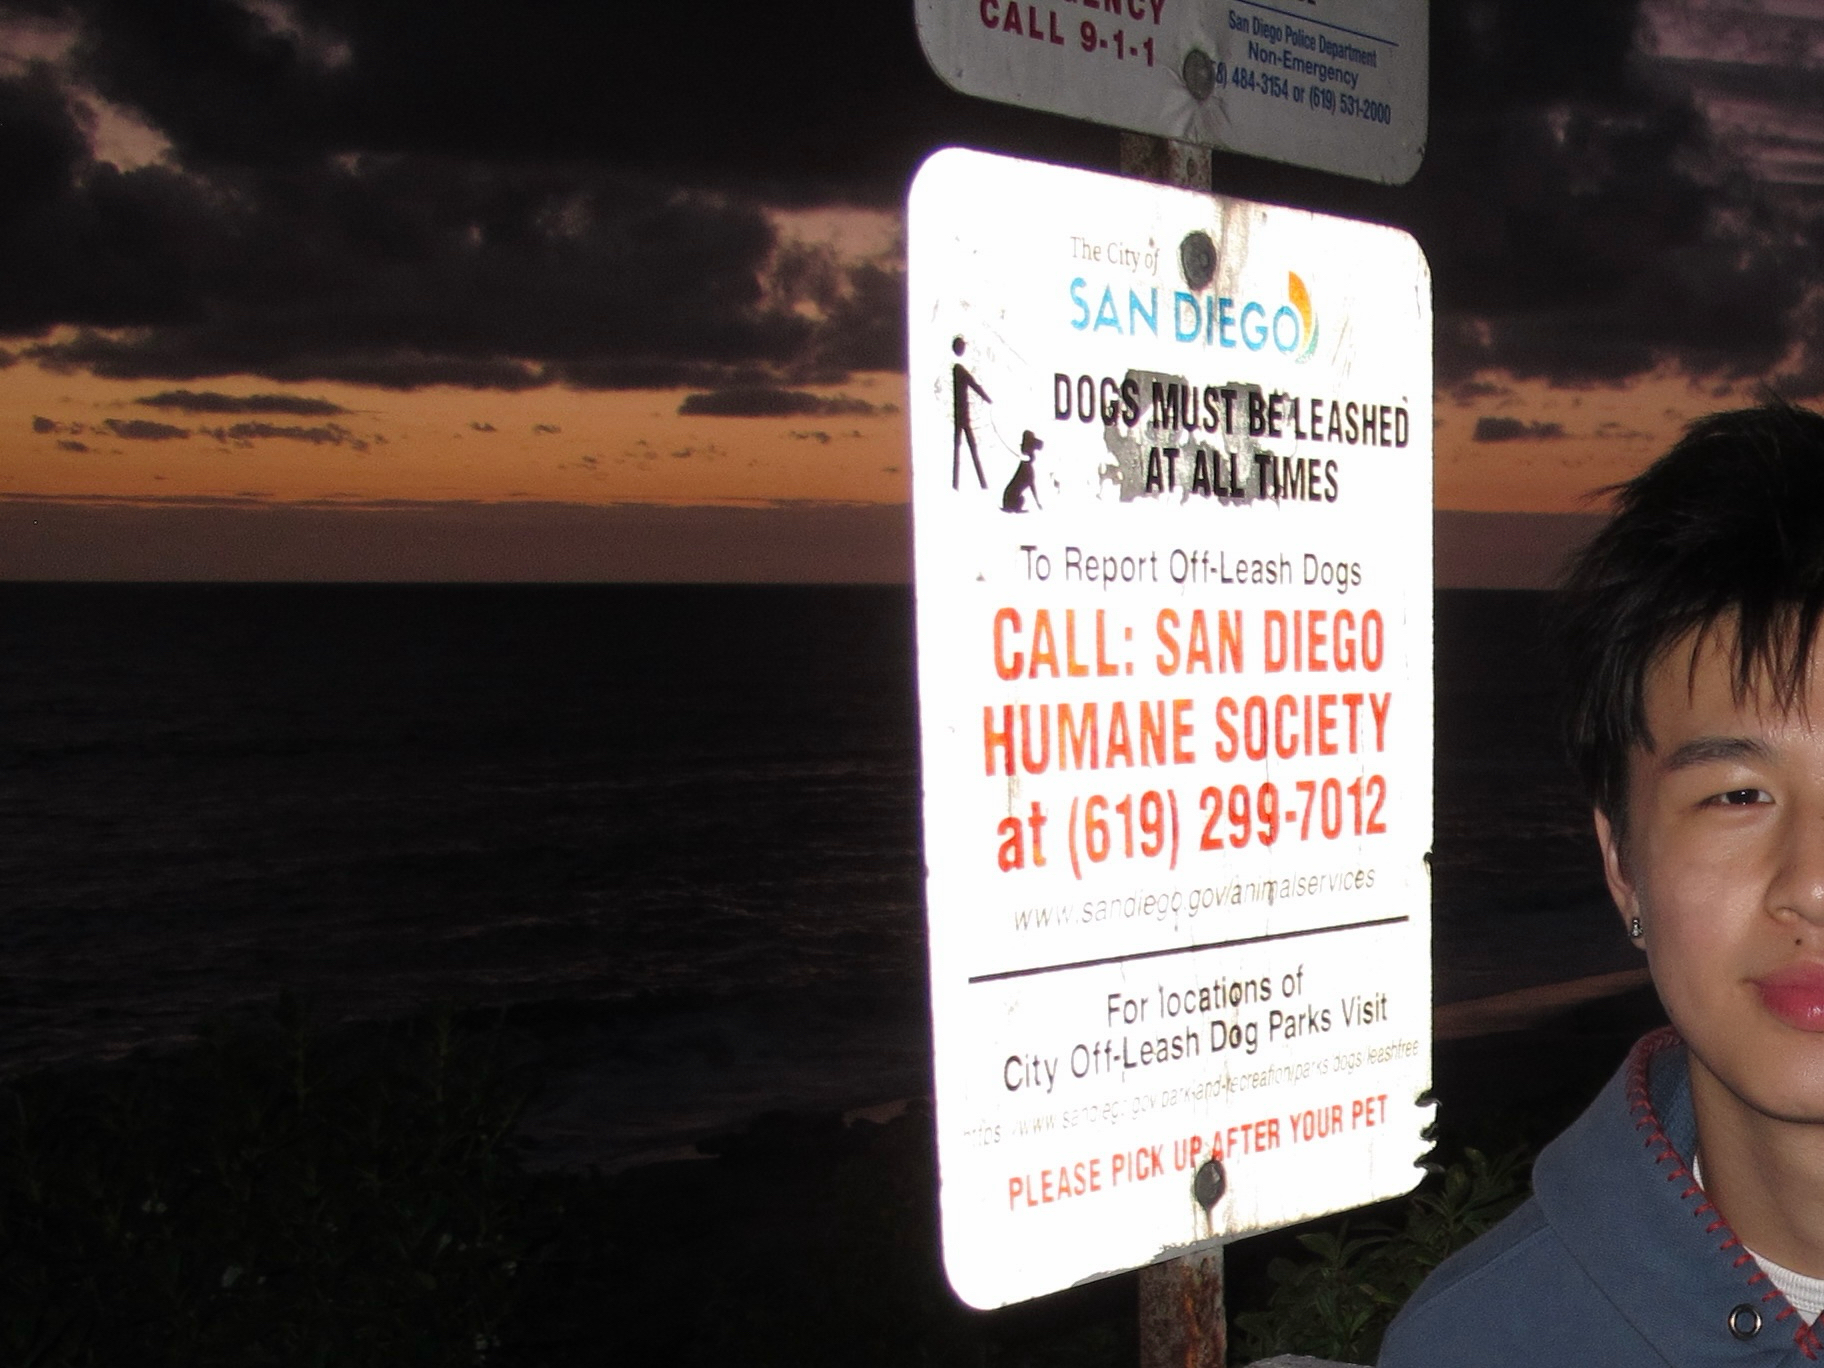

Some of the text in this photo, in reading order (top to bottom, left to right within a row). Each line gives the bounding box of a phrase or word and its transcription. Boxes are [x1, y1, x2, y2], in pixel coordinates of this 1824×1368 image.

[980, 0, 1065, 46] CALL
[1080, 20, 1155, 67] 9-1-1
[1229, 9, 1378, 68] San Diego Police Department
[1248, 40, 1359, 90] Non-Emergency
[1232, 66, 1289, 100] 484-3154
[1293, 84, 1306, 102] or
[1309, 84, 1337, 115] (619)
[1340, 93, 1392, 126] 531-2000
[1070, 236, 1160, 276] The City of
[1069, 276, 1300, 353] SAN DIEGO
[1054, 373, 1410, 449] DOGS MUST BE LEASHED
[1145, 446, 1339, 503] AT ALL TIMES
[1020, 545, 1362, 594] To Report Off-Leash Dogs
[993, 607, 1385, 681] CALL: SAN DIEGO
[983, 692, 1393, 777] HUMANE SOCIETY
[996, 774, 1388, 880] at (619) 299-7012
[1013, 867, 1376, 931] www.sandiego.gov/animalservices
[1107, 965, 1304, 1027] For locations of
[1003, 991, 1388, 1094] City Off-Leash Dog Parks Visit
[1009, 1093, 1389, 1211] PLEASE PICK UP AFTER YOUR PET
